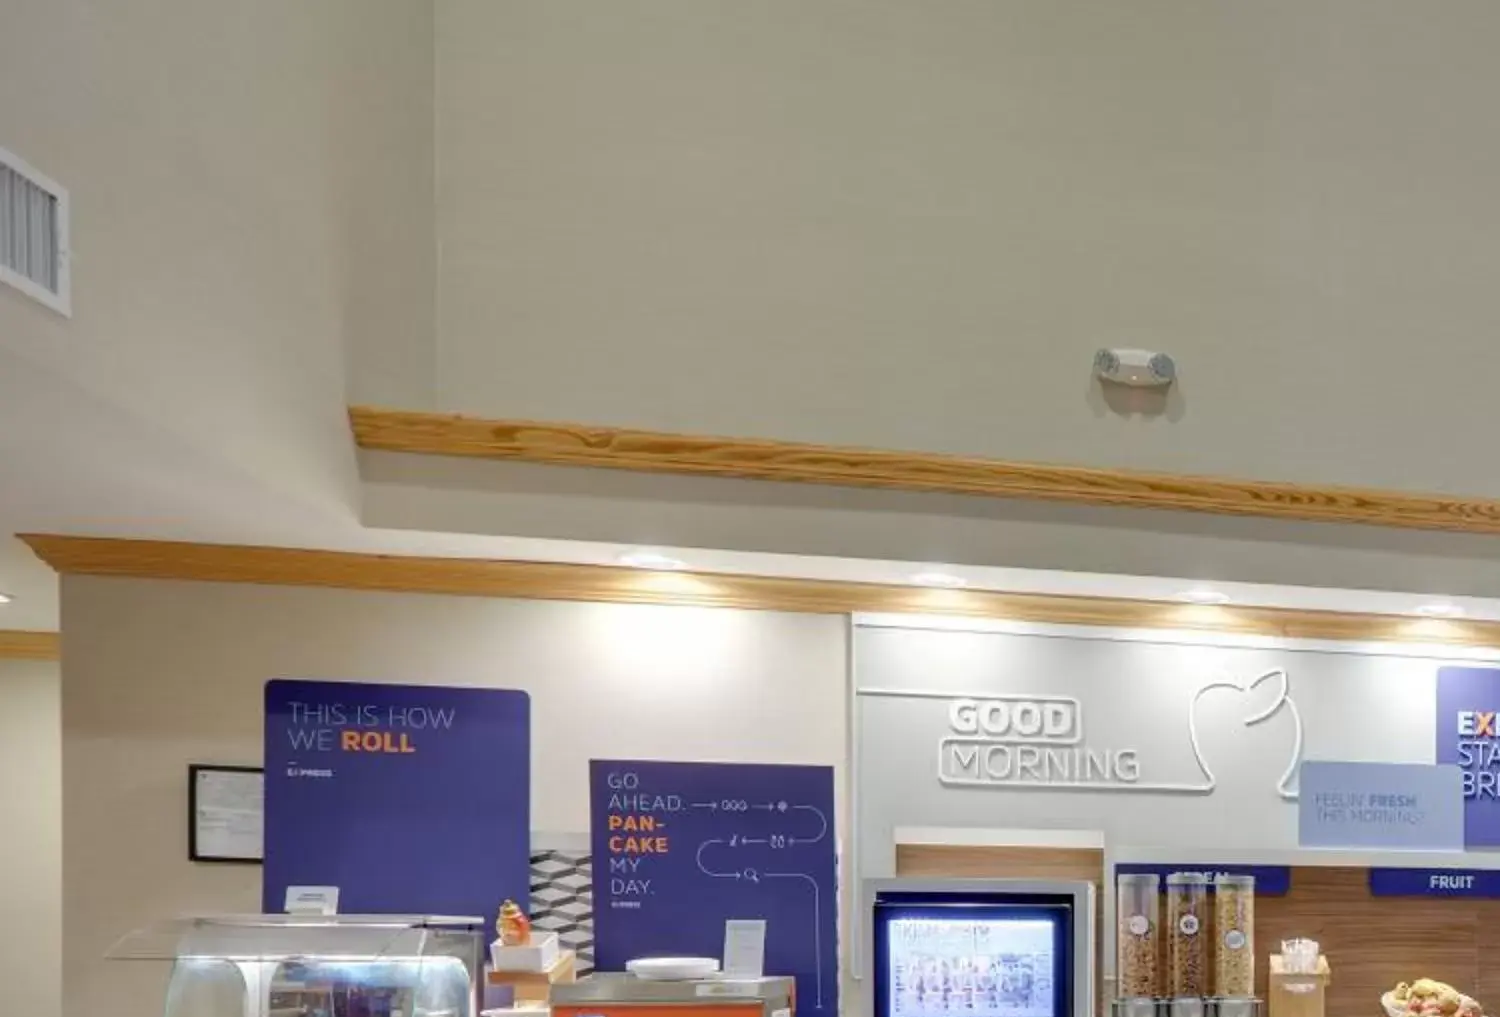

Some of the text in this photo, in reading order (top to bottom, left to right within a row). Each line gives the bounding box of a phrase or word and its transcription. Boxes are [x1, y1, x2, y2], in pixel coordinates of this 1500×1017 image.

[288, 702, 456, 729] THIS IS HOW
[949, 700, 1072, 736] GOOD
[288, 728, 416, 753] WE ROLL
[951, 744, 1140, 782] MORNING
[607, 772, 639, 789] GO
[608, 794, 687, 811] AHEAD.
[1369, 793, 1417, 807] FRESH
[608, 815, 666, 831] PAN-
[609, 836, 669, 853] CAKE
[609, 858, 640, 873] MY
[610, 879, 655, 895] DAY.
[1430, 875, 1475, 889] FRUIT
